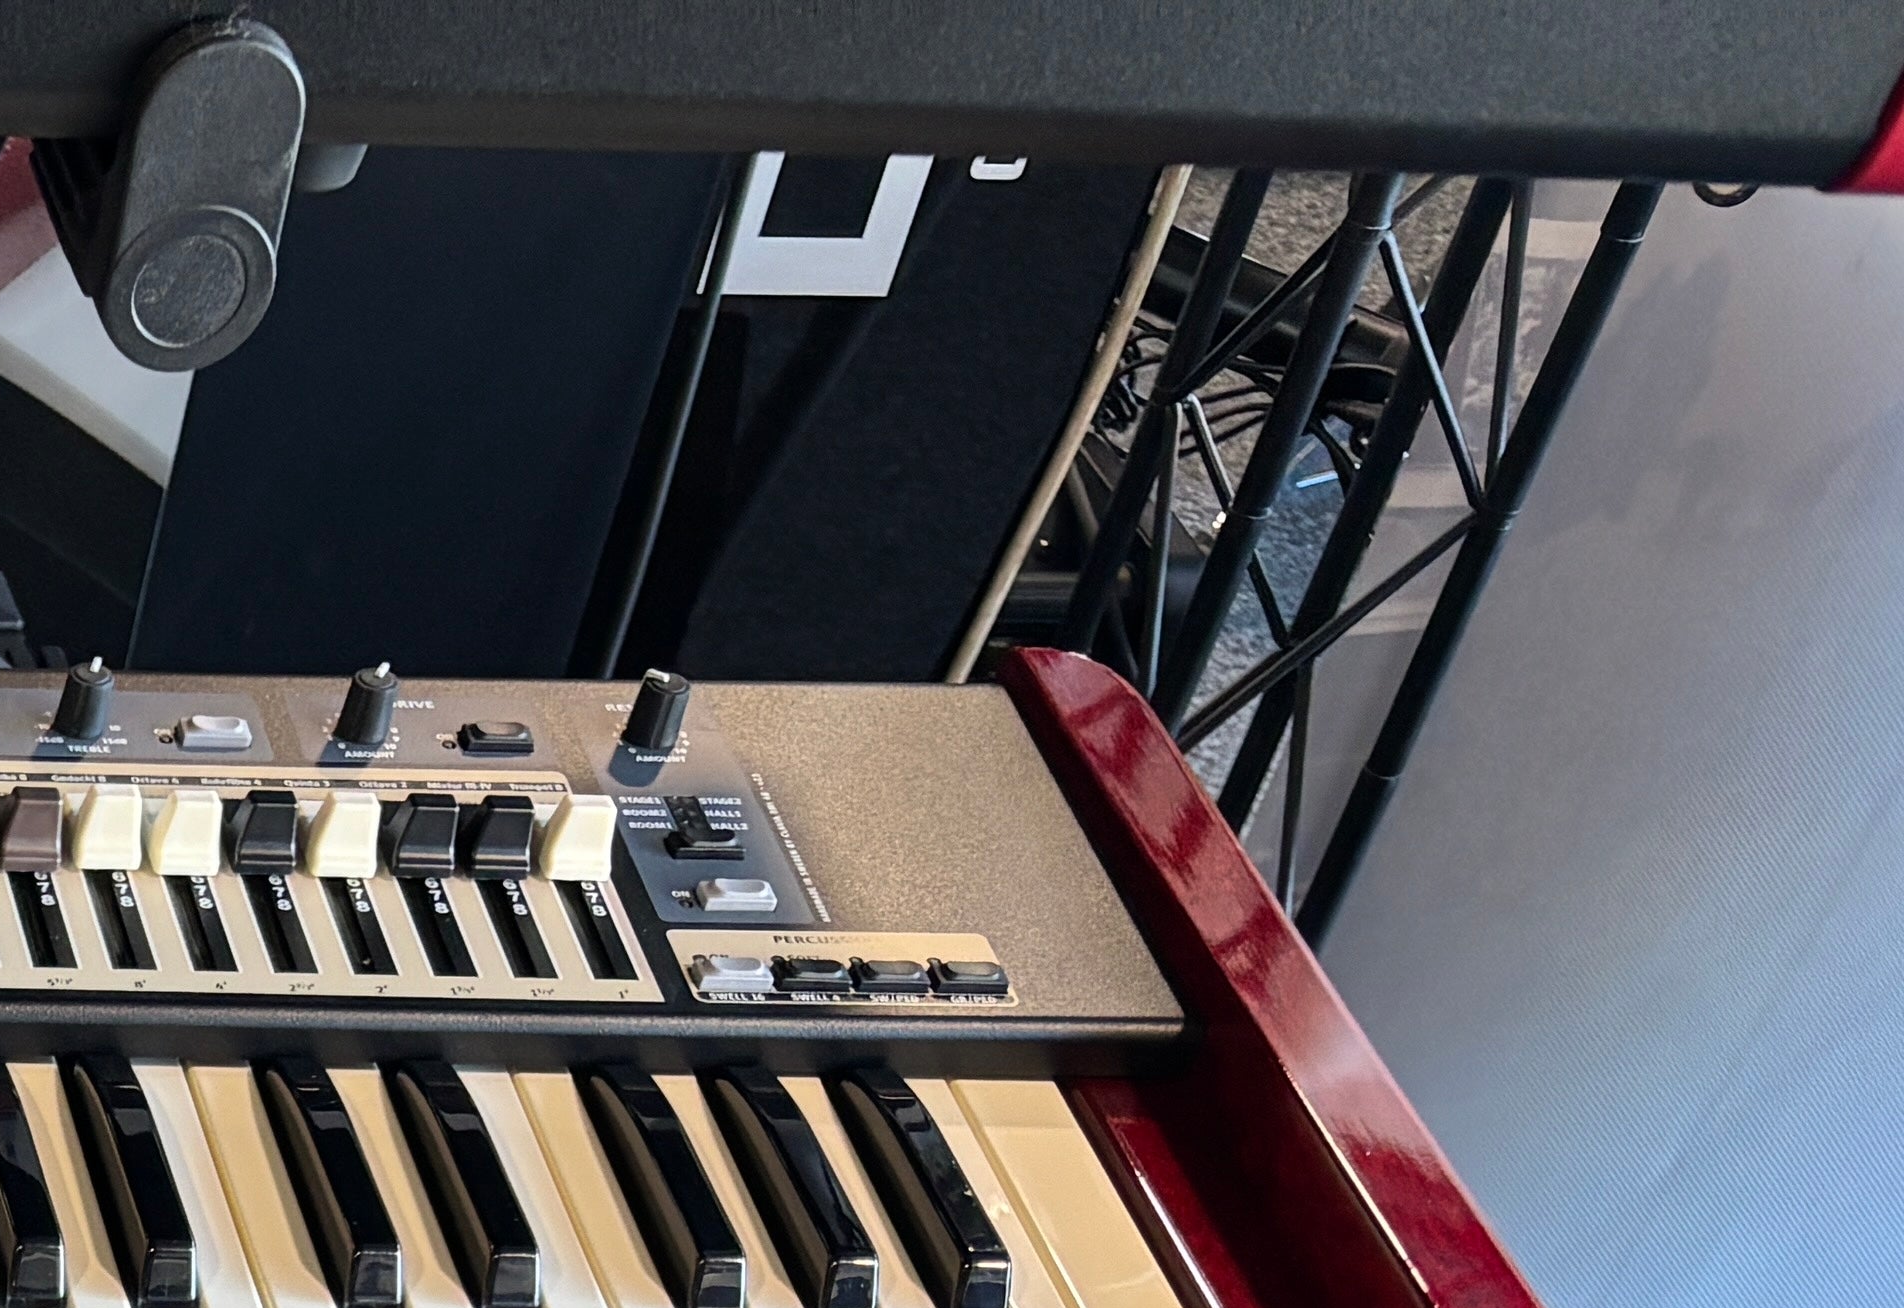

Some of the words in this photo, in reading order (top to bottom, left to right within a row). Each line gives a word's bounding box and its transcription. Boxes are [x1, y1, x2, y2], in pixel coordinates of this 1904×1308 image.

[392, 700, 435, 710] RIVE
[68, 744, 111, 754] TREBLE
[344, 750, 394, 759] AMOUNT
[635, 755, 686, 763] AMOUNT
[428, 889, 442, 901] 7
[672, 890, 690, 898] ON
[434, 901, 450, 914] 8
